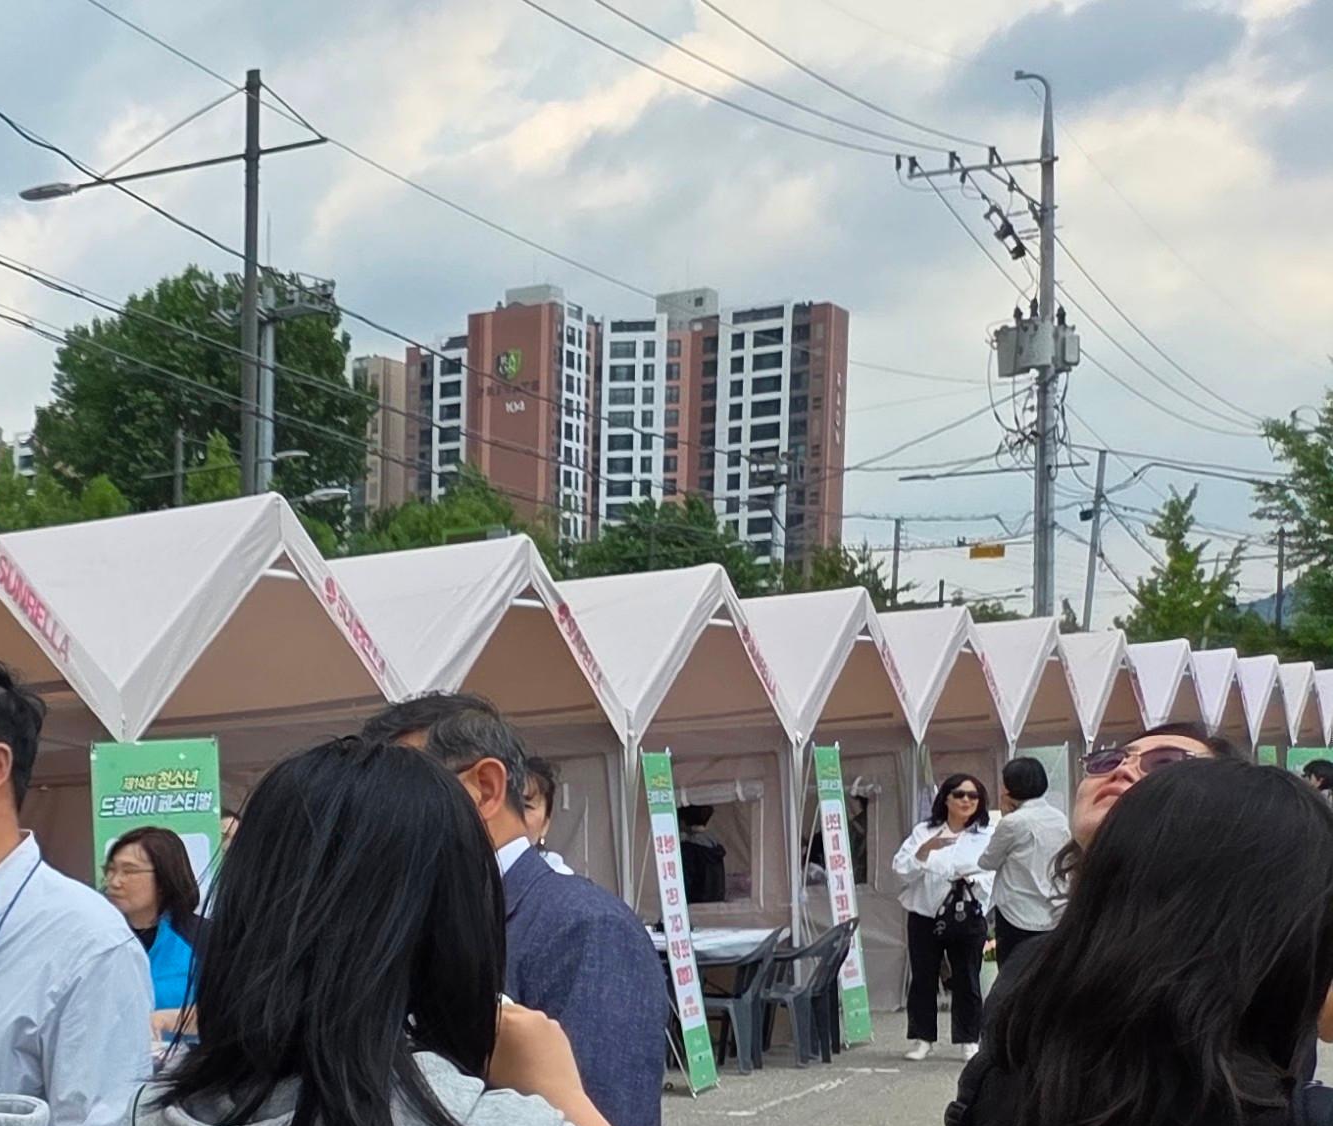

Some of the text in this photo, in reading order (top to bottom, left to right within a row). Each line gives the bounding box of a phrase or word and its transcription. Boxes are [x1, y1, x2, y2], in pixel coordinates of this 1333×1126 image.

[158, 767, 199, 791] 청소년
[99, 791, 213, 817] 드림하이 페스티벌
